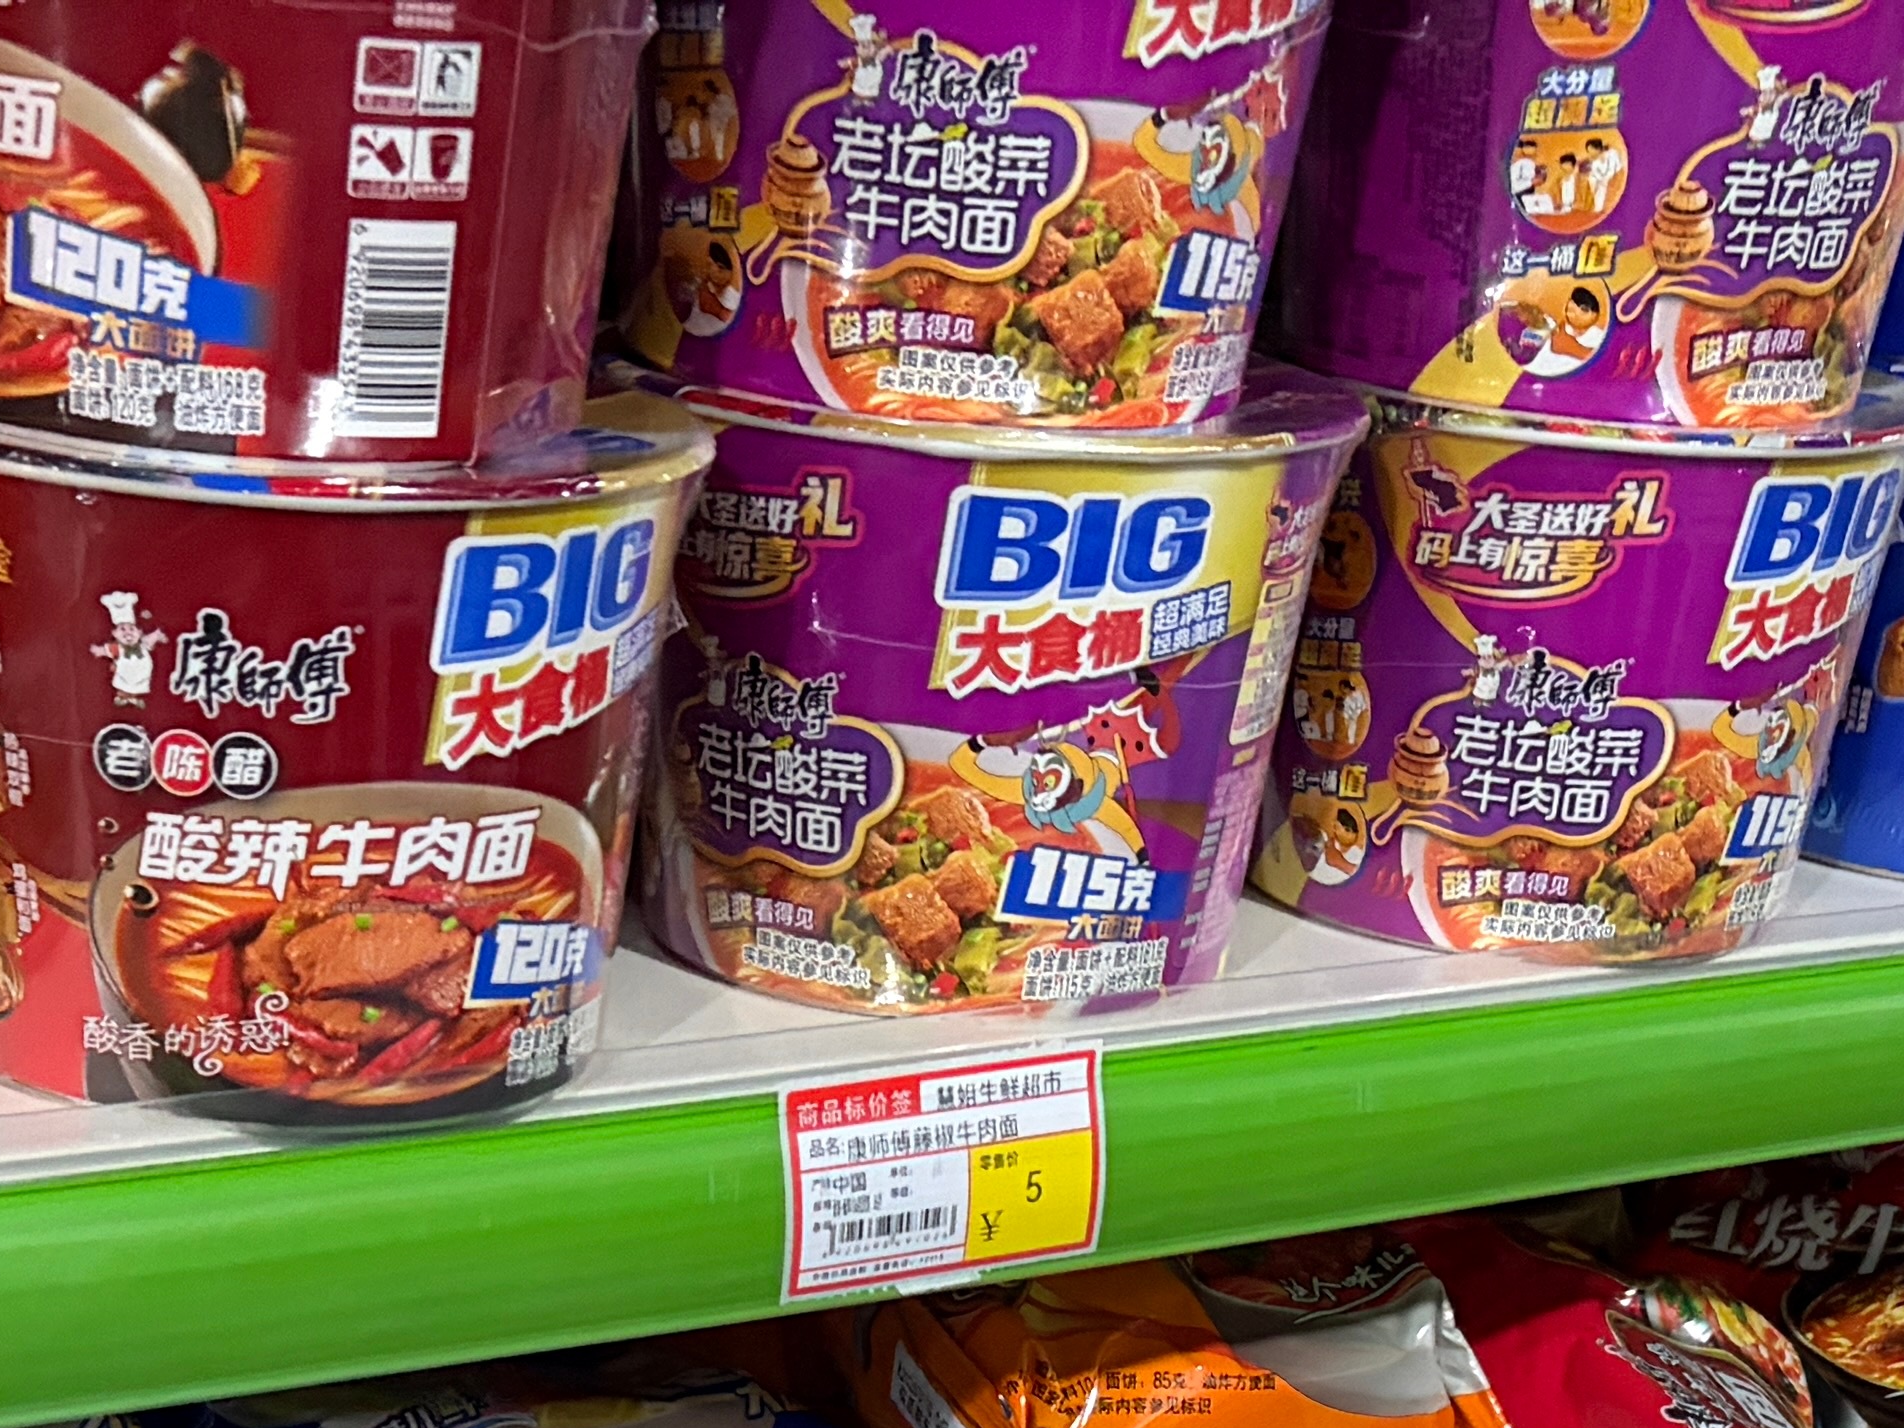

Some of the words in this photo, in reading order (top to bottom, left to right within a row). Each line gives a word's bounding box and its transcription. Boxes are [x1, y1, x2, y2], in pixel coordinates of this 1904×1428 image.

[894, 31, 1028, 127] 康師傅
[831, 115, 1051, 200] 老坛酸菜
[1718, 157, 1881, 220] 老坛酸菜
[847, 193, 1020, 258] 牛肉面
[1502, 235, 1620, 277] 这一桶值
[1725, 218, 1851, 271] 牛肉面
[23, 210, 192, 322] 120克
[827, 306, 976, 351] 酸爽看得见
[1471, 477, 1667, 538] 大圣送好礼
[944, 492, 1213, 604] BIG
[1414, 531, 1615, 588] 码上有惊喜
[440, 515, 656, 668] BIG
[1152, 585, 1231, 632] 超满足
[173, 610, 354, 724] 康師傅
[952, 607, 1143, 694] 大食桶
[1151, 617, 1230, 658] 经典美味
[444, 646, 618, 767] 大食桶
[95, 725, 278, 799] 老陈醋
[698, 721, 872, 807] 老坛酸菜
[1451, 711, 1644, 781] 老坛酸菜
[708, 788, 844, 856] 牛肉面
[1461, 768, 1613, 823] 牛肉面
[140, 807, 543, 901] 酸辣牛肉面
[1027, 846, 1157, 913] 115克
[1439, 866, 1571, 901] 酸爽看得见
[491, 921, 588, 988] 120克
[796, 1089, 913, 1128] 商品标价签
[1025, 1169, 1043, 1204] 5
[980, 1209, 1004, 1243] ¥
